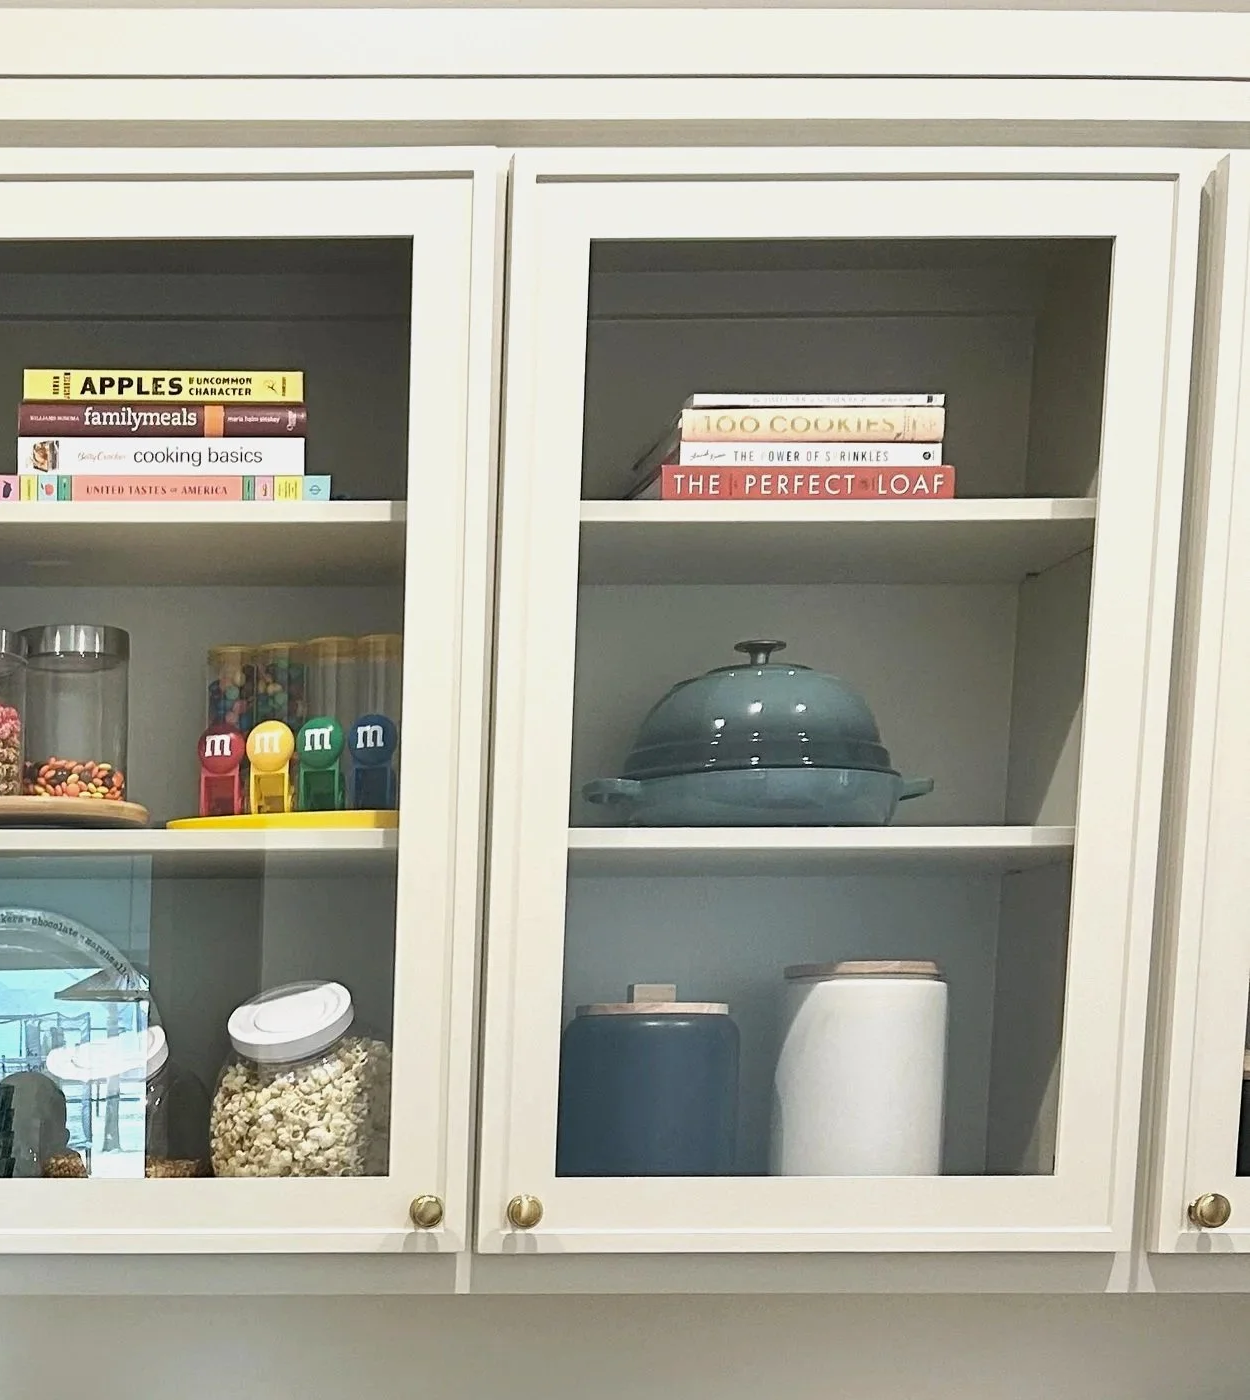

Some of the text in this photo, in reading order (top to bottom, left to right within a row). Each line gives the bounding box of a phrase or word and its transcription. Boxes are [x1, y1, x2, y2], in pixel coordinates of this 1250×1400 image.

[80, 376, 183, 396] APPLES
[196, 377, 252, 385] UNCOMMON
[188, 387, 252, 396] CHARACTER
[84, 406, 197, 431] familymeals
[704, 415, 760, 433] 100
[769, 415, 895, 433] COOKIES
[133, 446, 263, 467] cooking basics
[733, 450, 754, 462] THE
[806, 451, 820, 461] OF
[86, 485, 124, 494] UNITED
[128, 485, 167, 494] TASTES
[181, 485, 228, 495] AMERICA
[673, 474, 944, 495] THE PERFECT LOAF
